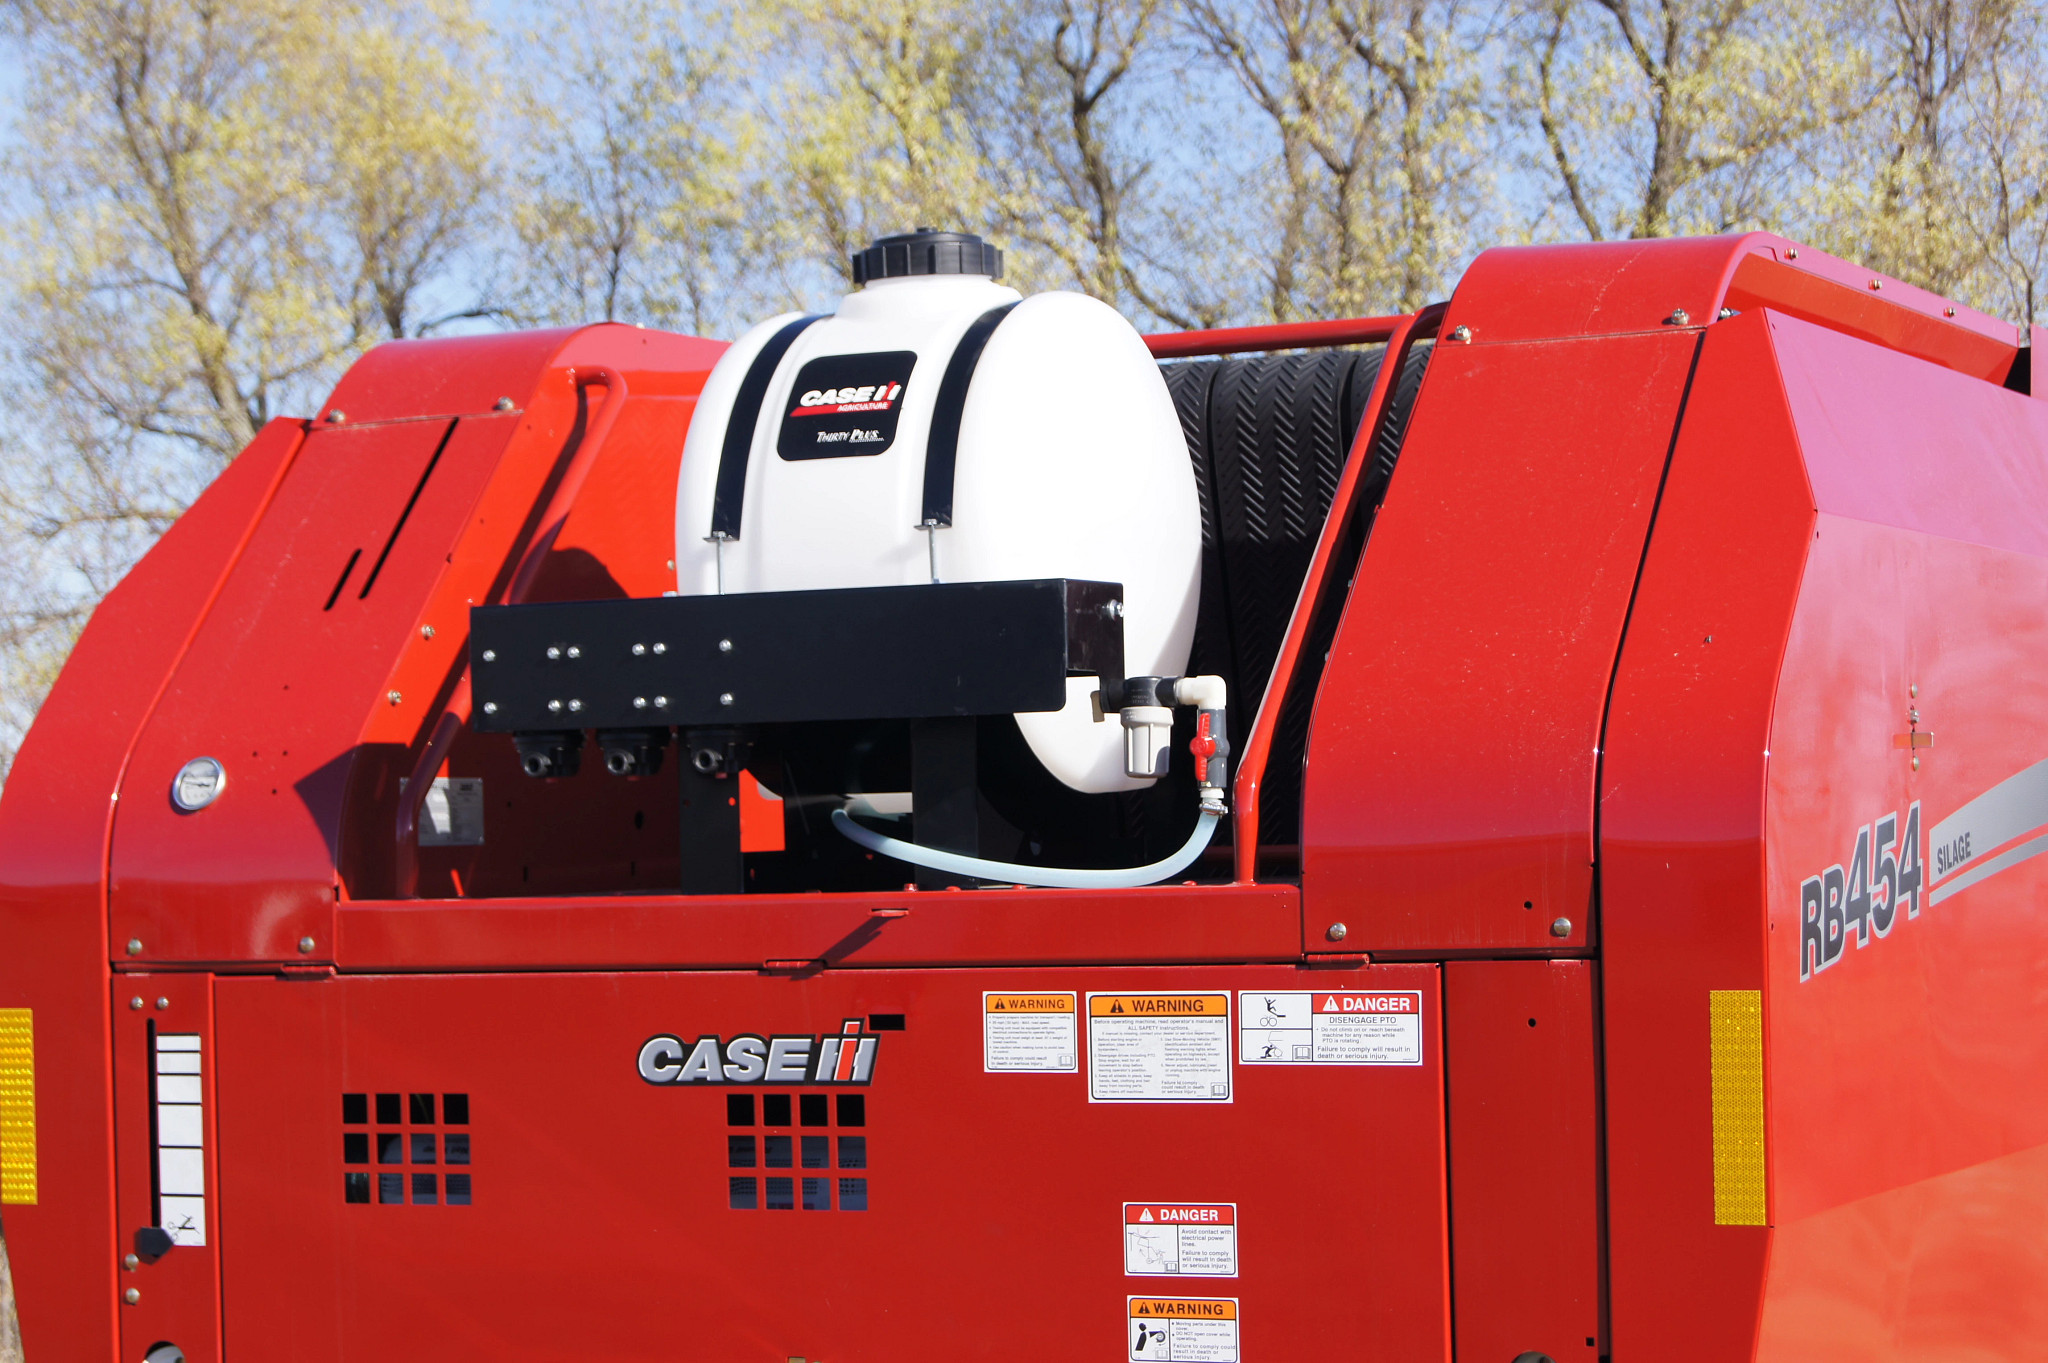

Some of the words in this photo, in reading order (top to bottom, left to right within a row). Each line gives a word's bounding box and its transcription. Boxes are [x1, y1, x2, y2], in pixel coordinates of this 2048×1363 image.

[800, 385, 876, 407] CASE
[837, 402, 889, 412] AGRICULTURE
[1937, 832, 1971, 874] SILAGE
[1800, 799, 1923, 983] RB454
[1008, 999, 1065, 1008] WARNING
[1132, 1000, 1204, 1012] WARNING
[1343, 998, 1410, 1011] DANGER
[638, 1036, 812, 1082] CASE
[1160, 1209, 1219, 1221] DANGER
[1153, 1303, 1223, 1315] WARNING
